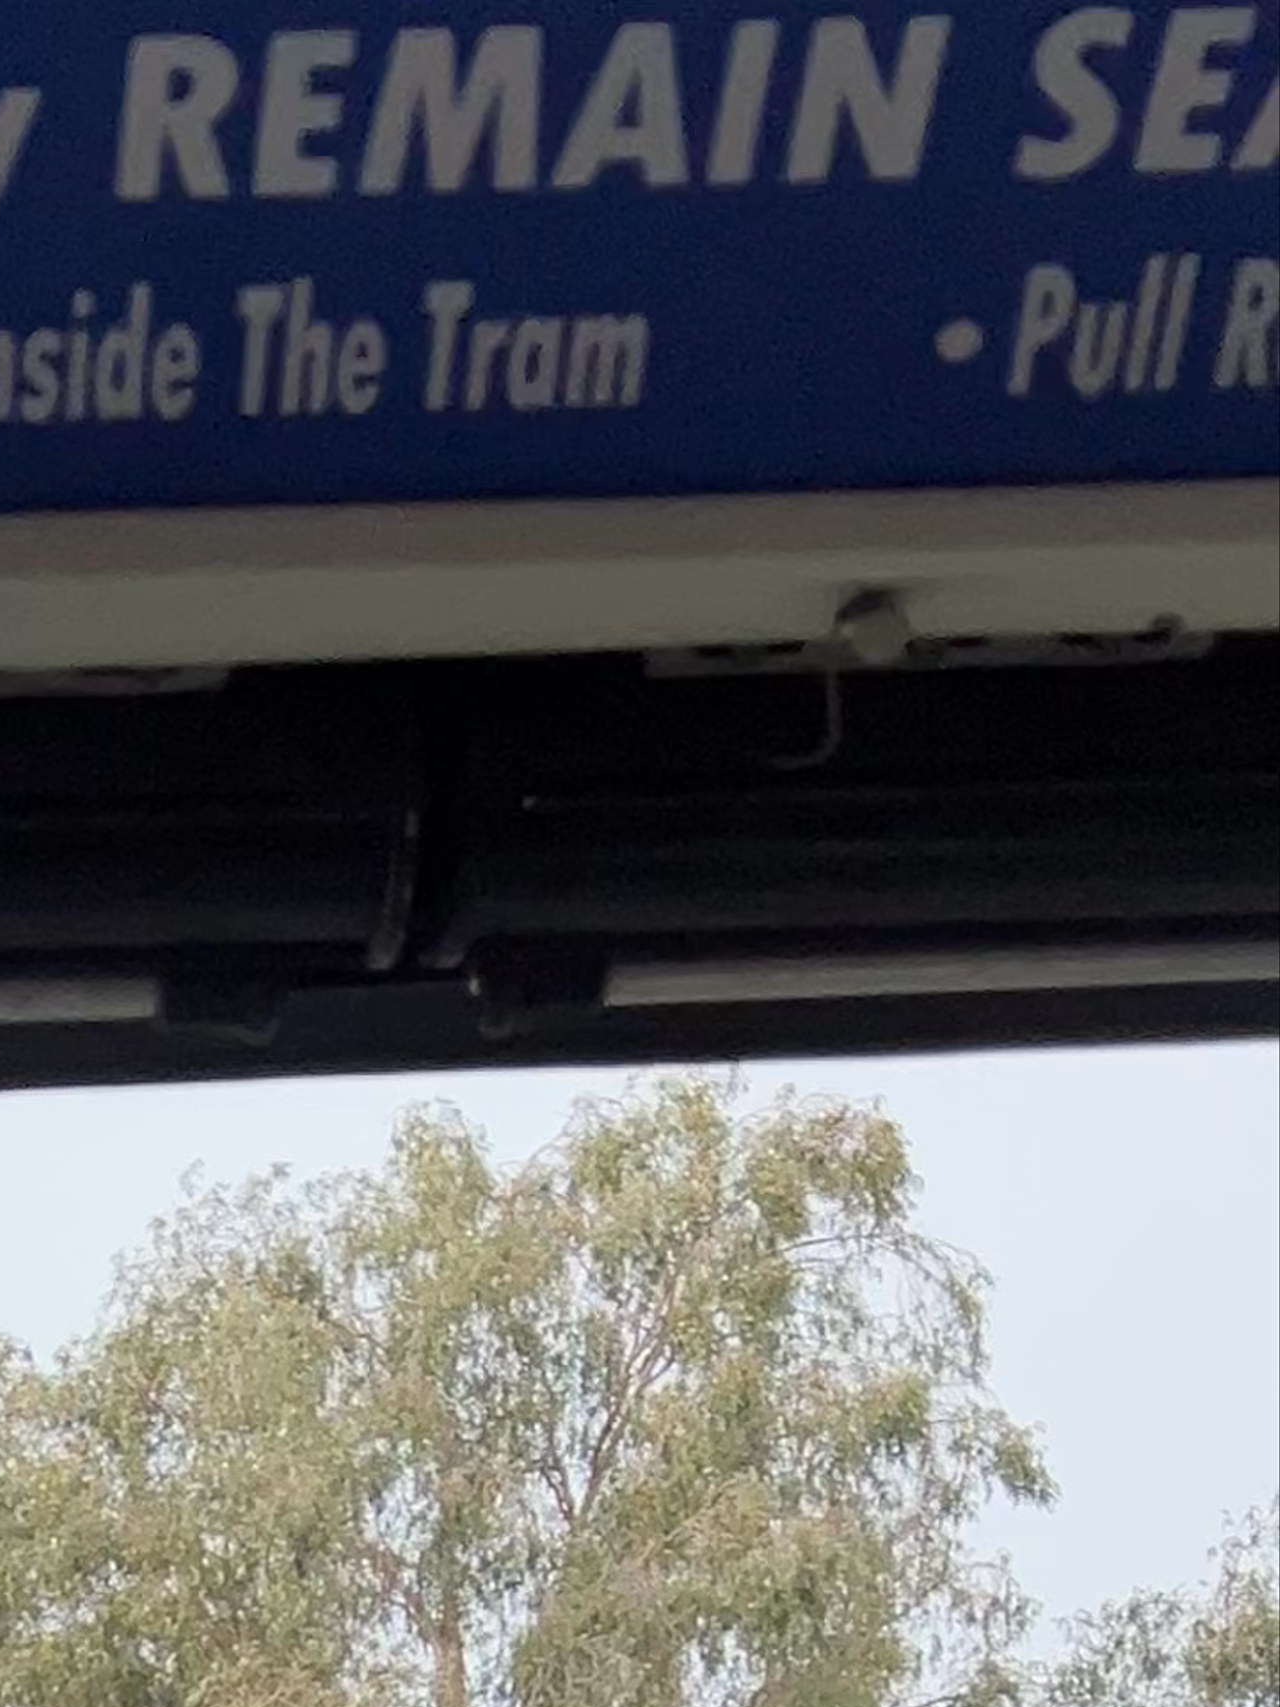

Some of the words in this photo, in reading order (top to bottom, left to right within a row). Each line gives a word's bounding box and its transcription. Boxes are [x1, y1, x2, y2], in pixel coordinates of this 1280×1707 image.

[114, 15, 952, 201] REMAIN
[236, 276, 388, 417] The
[423, 279, 650, 412] Tram
[1006, 252, 1202, 398] Pull
